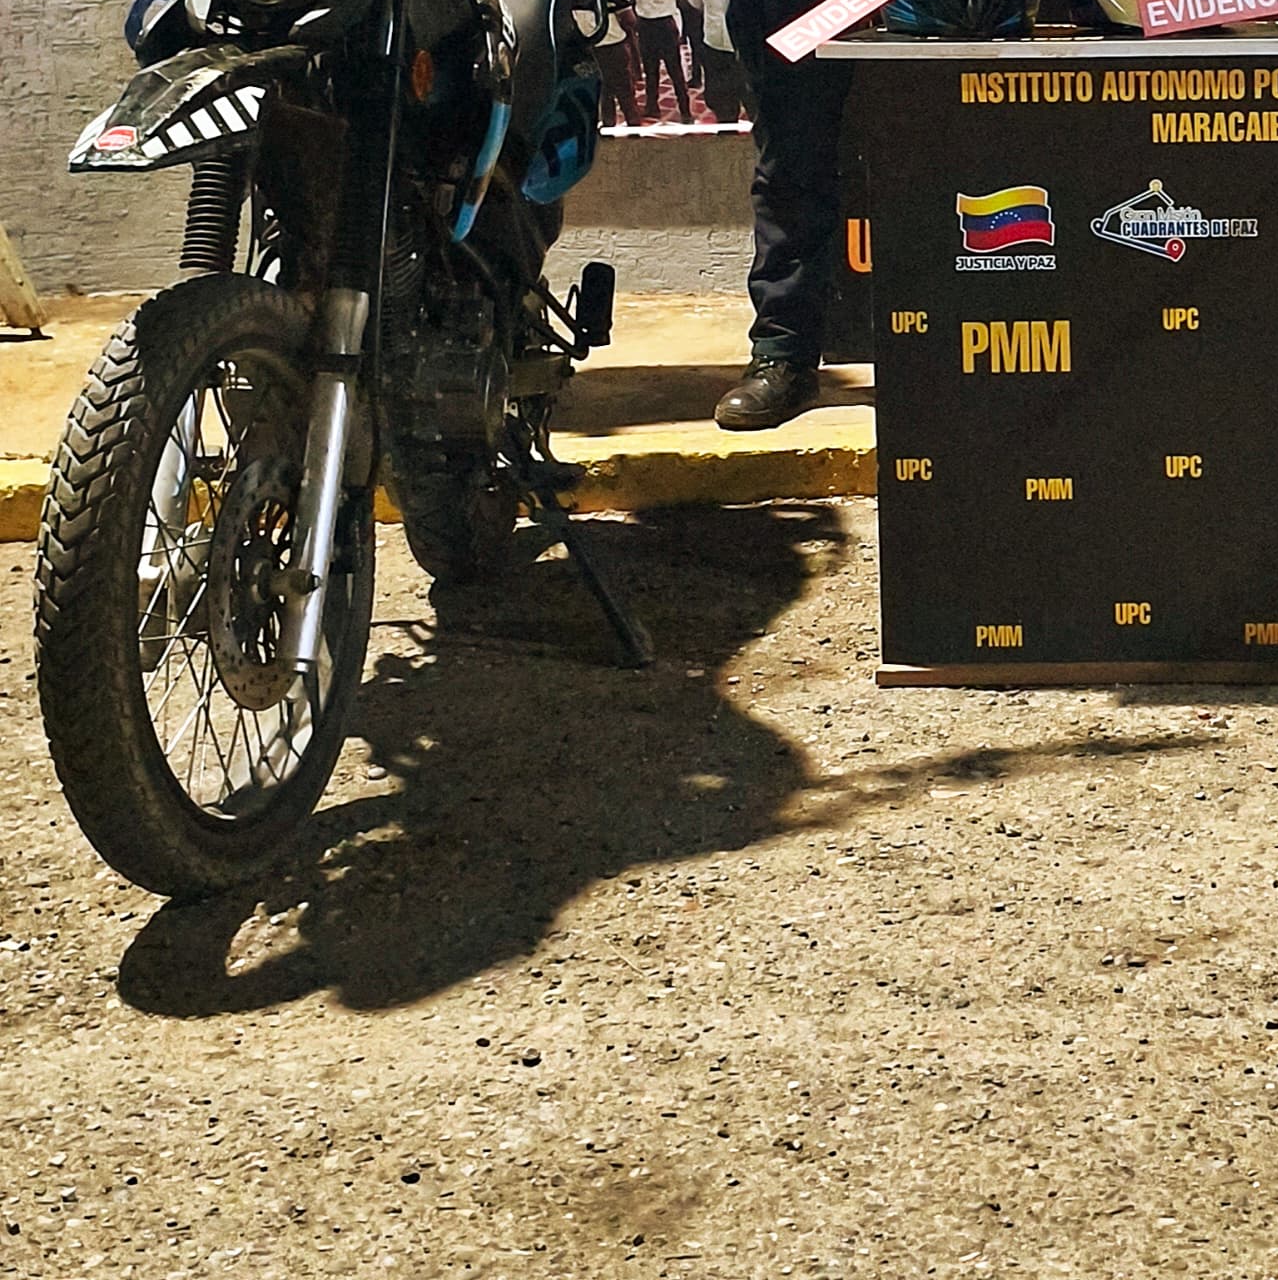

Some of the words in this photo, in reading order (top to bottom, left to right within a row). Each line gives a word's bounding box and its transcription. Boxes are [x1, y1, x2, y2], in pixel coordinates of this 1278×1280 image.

[961, 70, 1092, 103] INSTITUTO
[1102, 68, 1245, 102] AUTONOMO
[1122, 220, 1209, 237] CUADRANTES
[1211, 220, 1229, 236] DE
[1231, 220, 1258, 236] PAZ
[956, 256, 1015, 270] JUSTICIA
[1015, 255, 1027, 270] Y
[1027, 255, 1056, 270] PAZ
[892, 312, 927, 333] UPC
[1163, 308, 1198, 330] UPC
[962, 320, 1071, 373] PMM
[896, 458, 932, 480] UPC
[1166, 455, 1202, 477] UPC
[1026, 478, 1072, 500] PMM
[1115, 603, 1151, 624] UPC
[976, 625, 1022, 647] PMM
